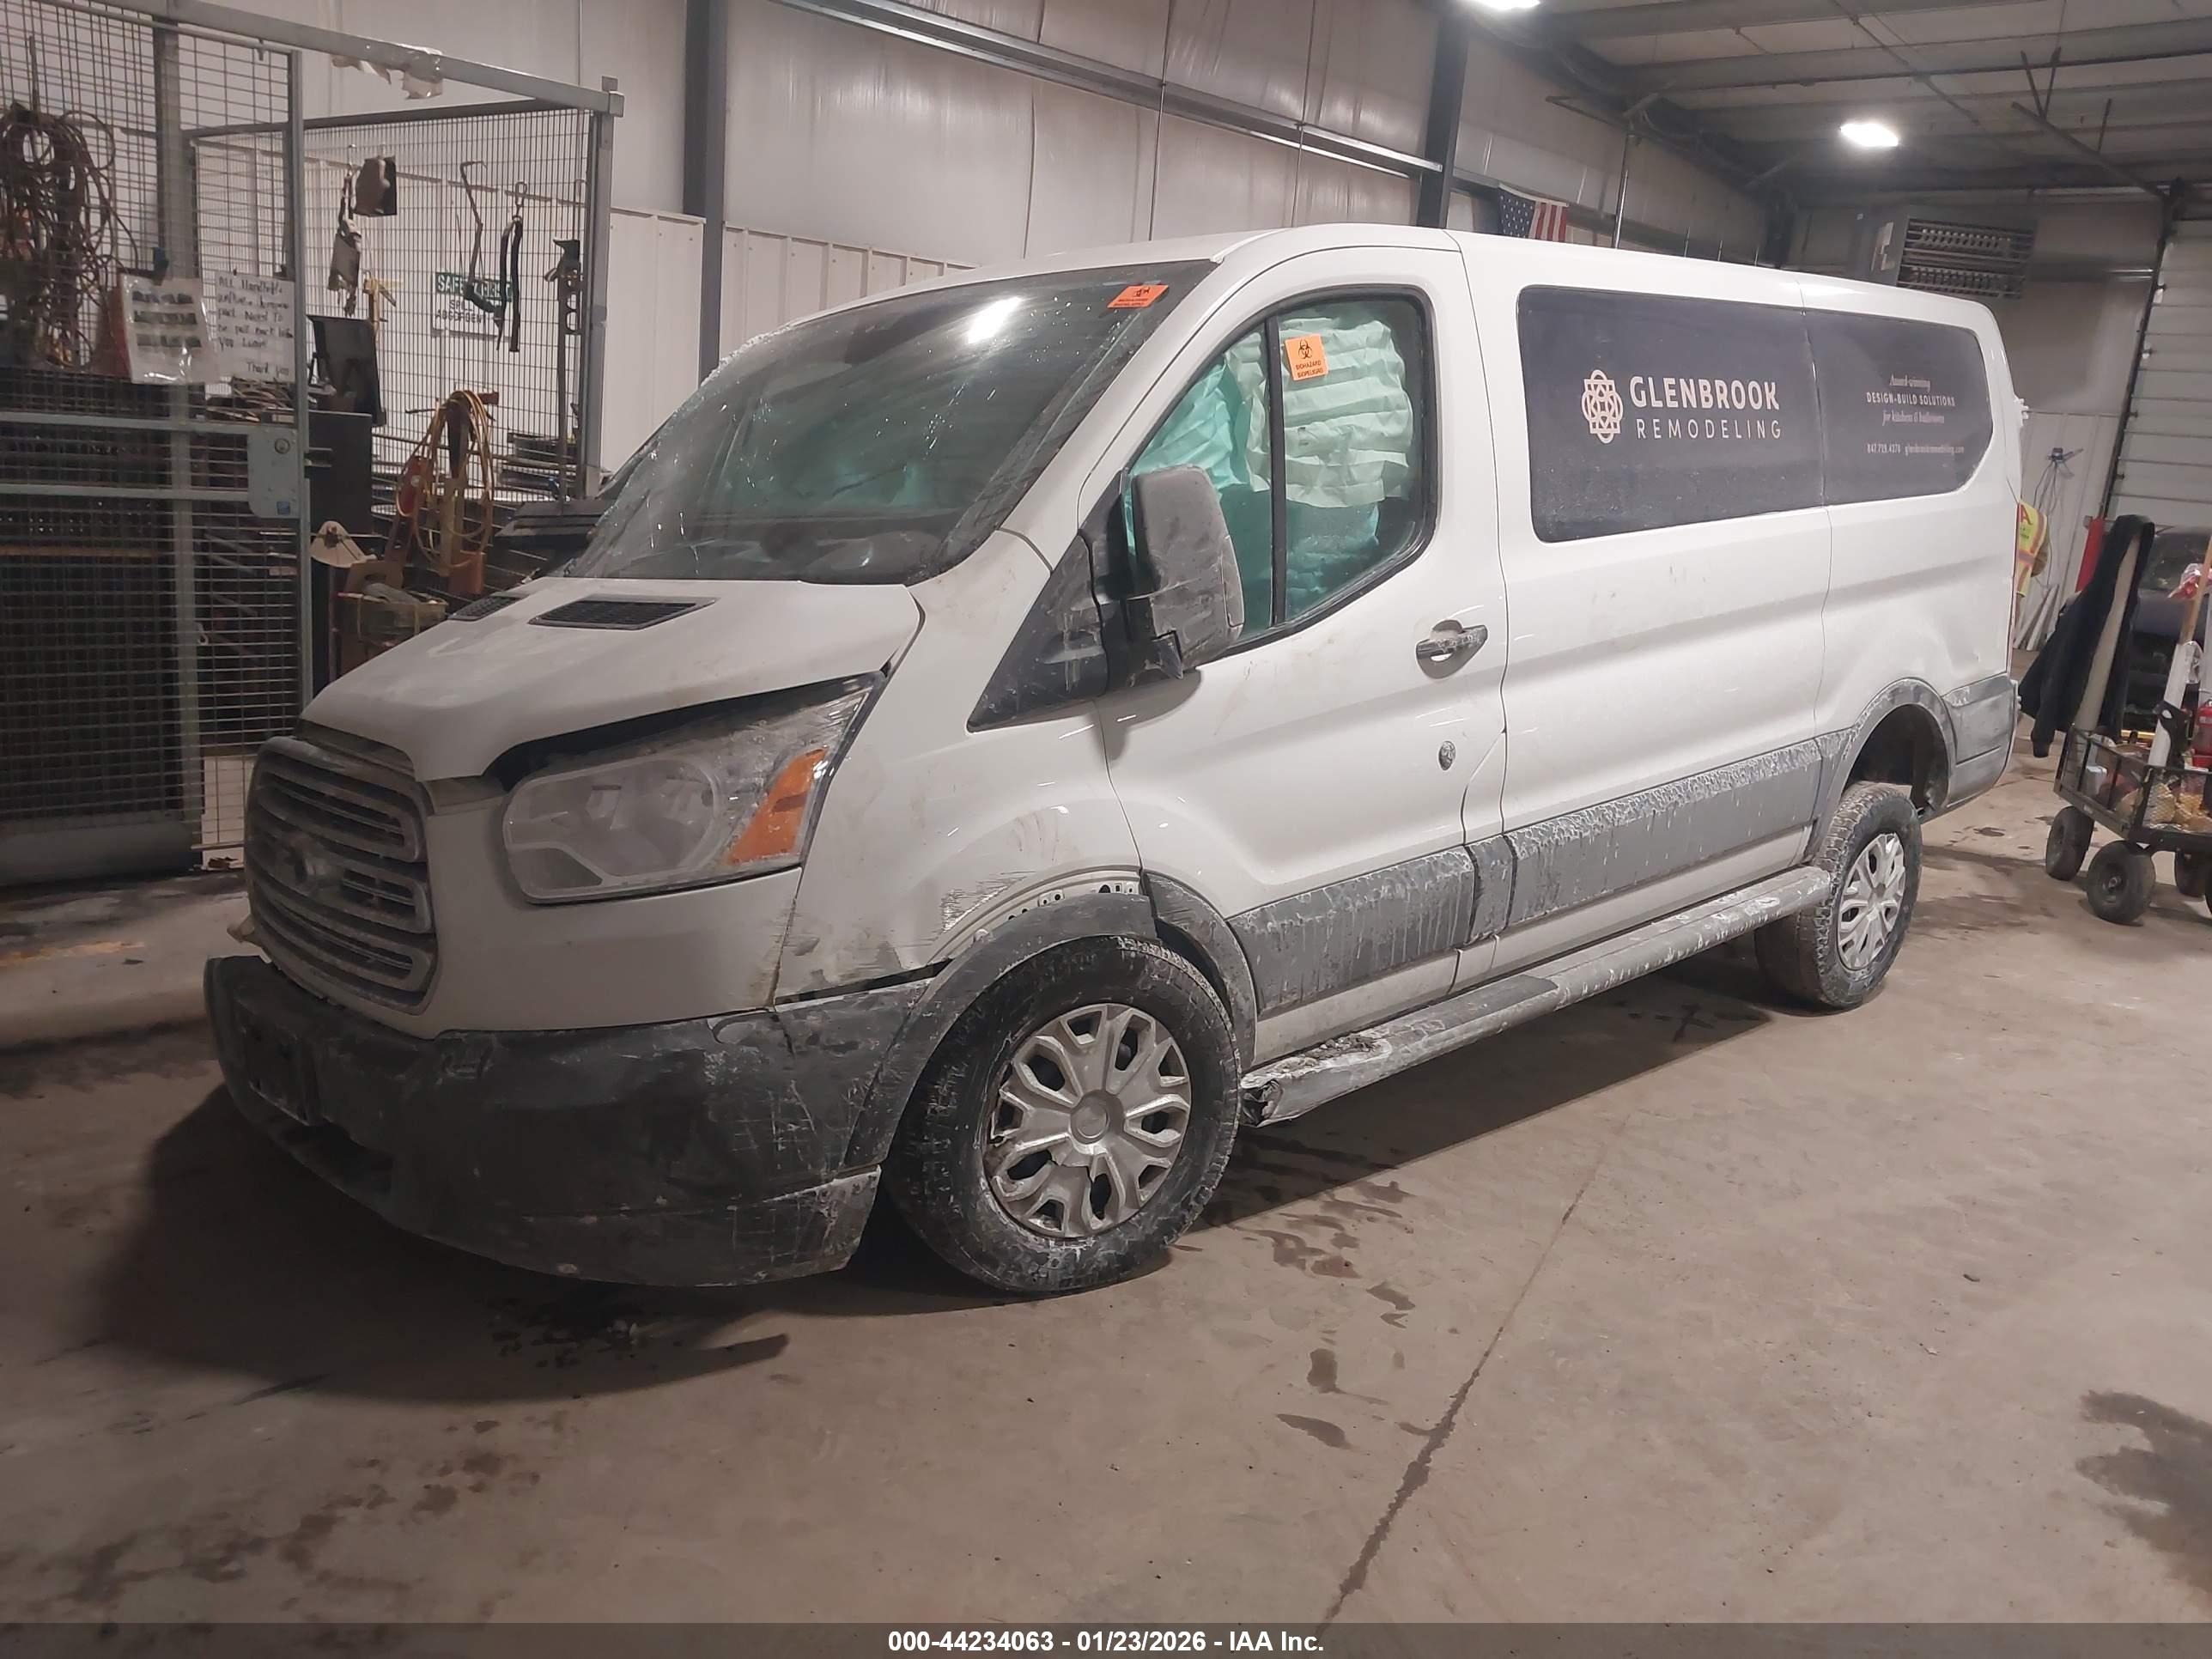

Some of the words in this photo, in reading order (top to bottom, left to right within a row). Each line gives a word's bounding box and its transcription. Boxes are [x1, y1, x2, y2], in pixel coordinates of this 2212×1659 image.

[1629, 375, 1779, 410] GLENBROOK
[1920, 395, 1956, 406] SOLUTIONS
[1636, 418, 1781, 439] REMODELING
